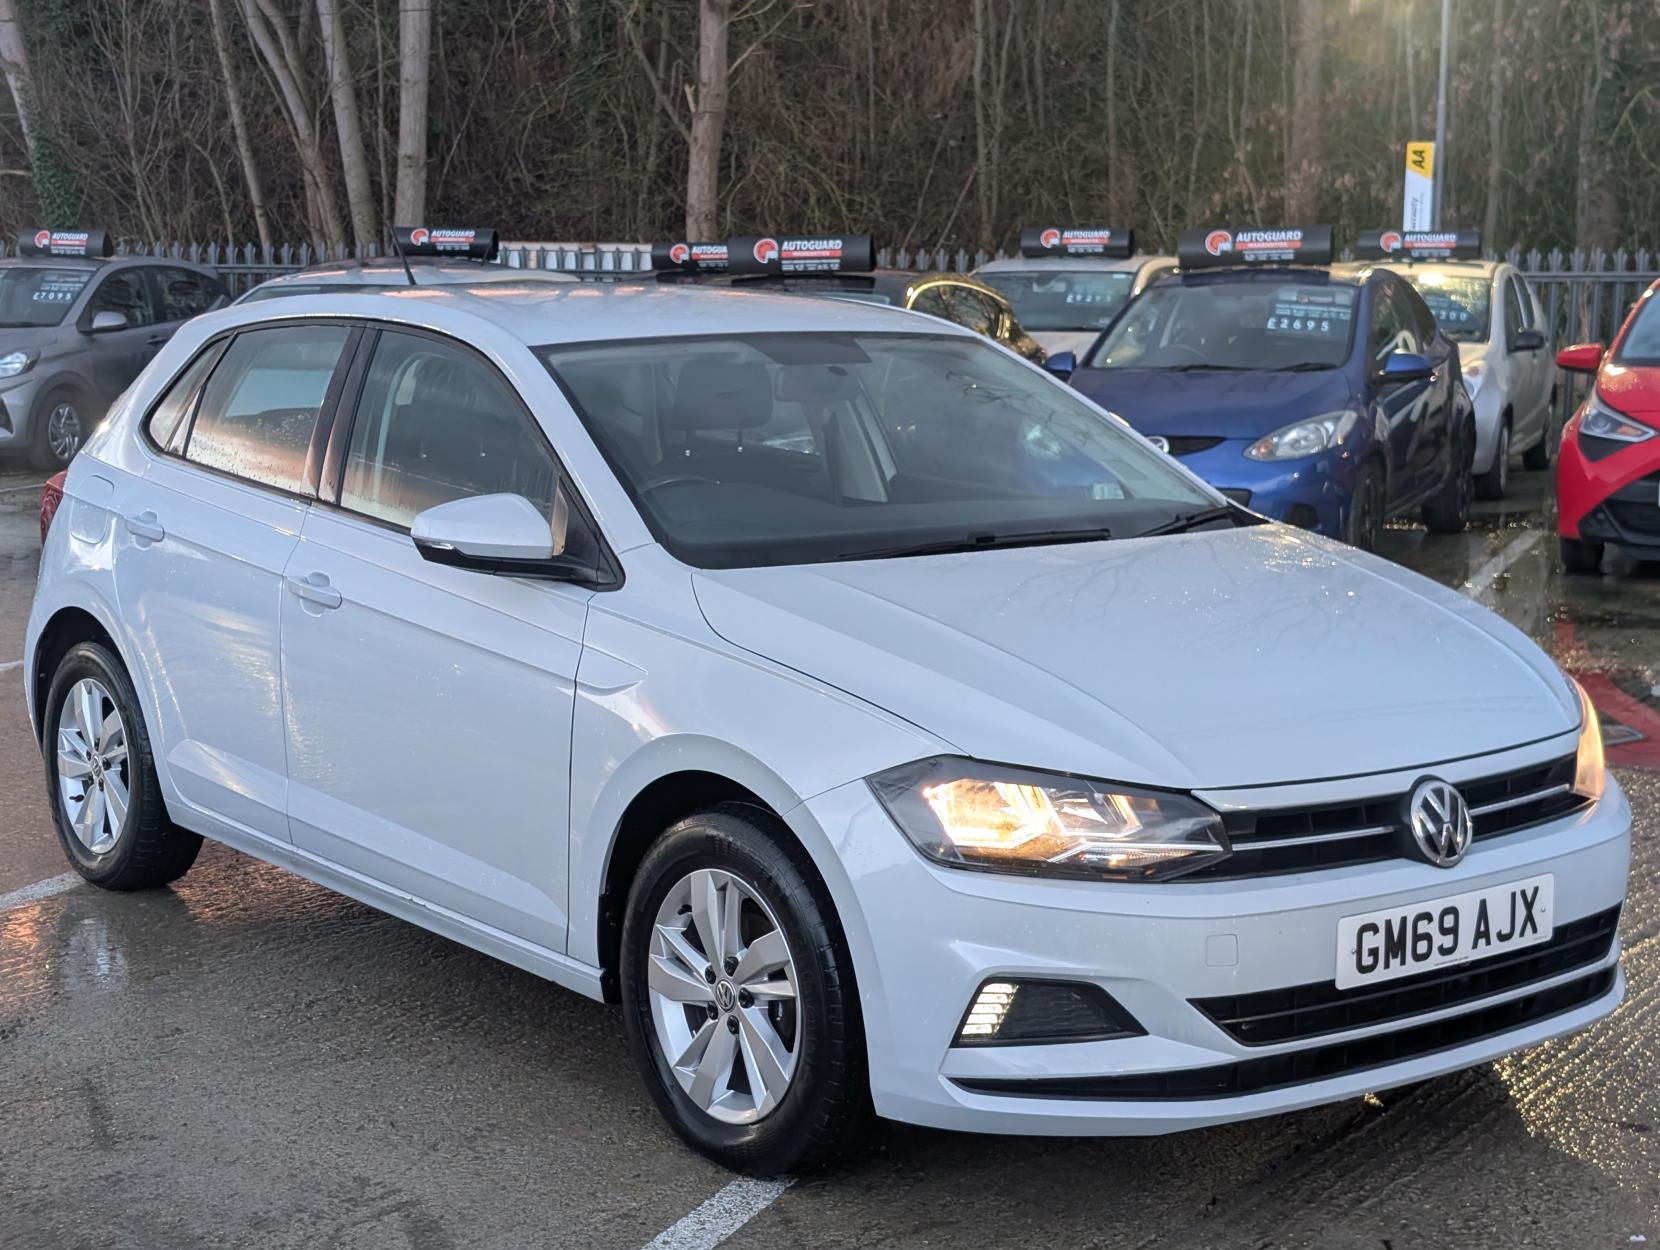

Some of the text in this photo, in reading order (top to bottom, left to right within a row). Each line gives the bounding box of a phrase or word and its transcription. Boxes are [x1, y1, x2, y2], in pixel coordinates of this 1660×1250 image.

[1411, 149, 1425, 170] AA
[52, 232, 88, 240] AUTOGUARD
[1063, 230, 1110, 238] AUTOGUARD
[1236, 231, 1302, 242] AUTOGUARD
[1404, 233, 1456, 241] AUTOGUARD
[692, 245, 728, 254] AUTOGUA
[781, 240, 842, 250] AUTOGUARD
[33, 292, 72, 300] £7095
[1267, 317, 1330, 332] £2695
[1355, 885, 1540, 975] GM69 AJX
